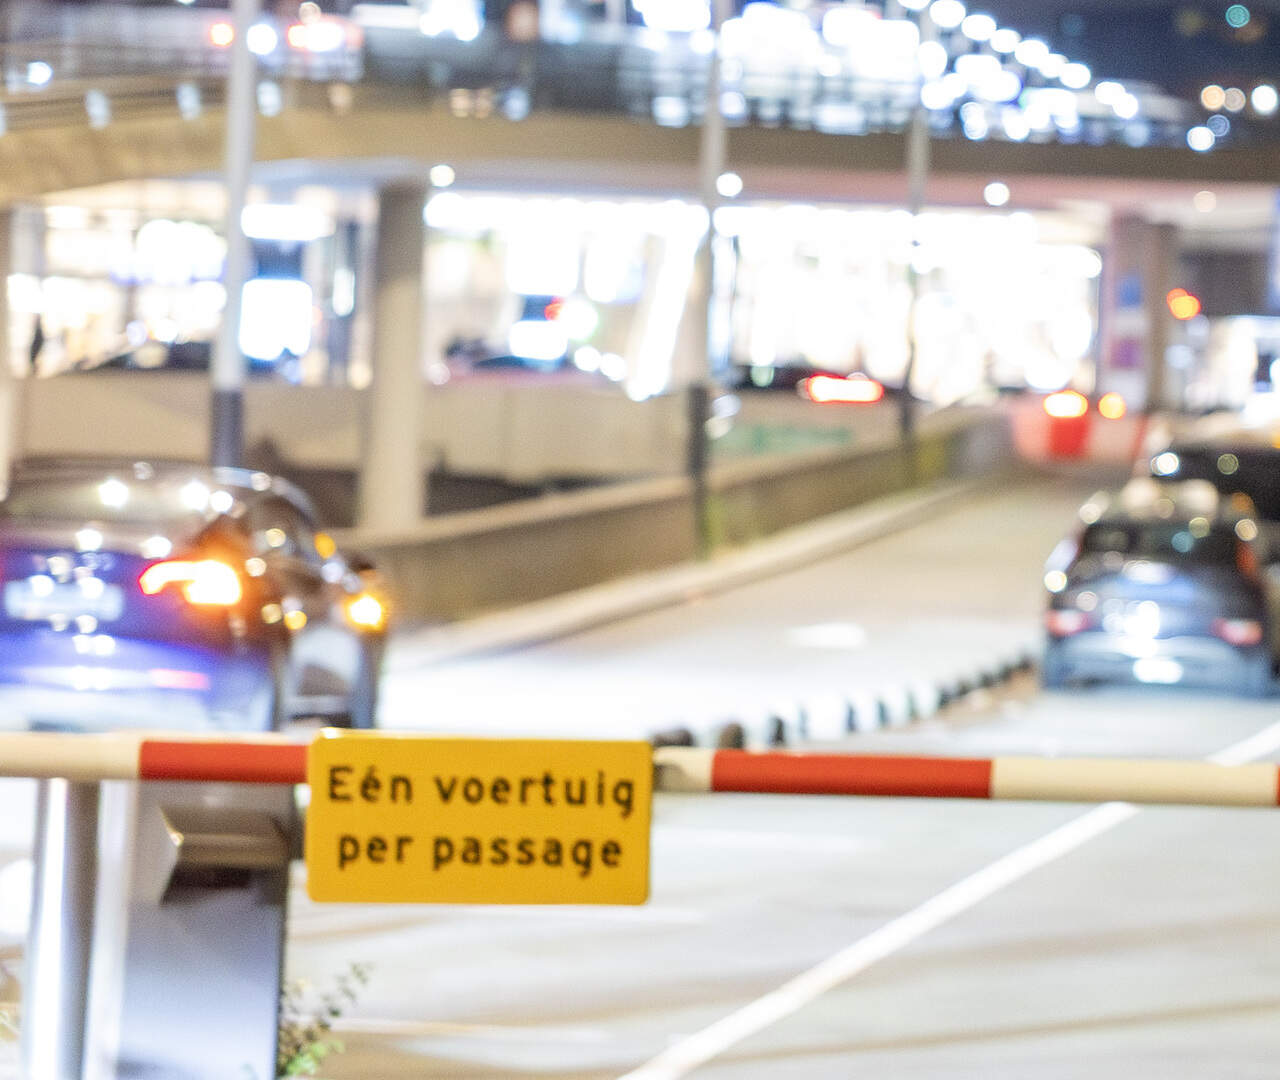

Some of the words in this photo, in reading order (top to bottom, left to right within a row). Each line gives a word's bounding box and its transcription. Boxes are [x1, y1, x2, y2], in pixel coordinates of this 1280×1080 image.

[328, 765, 414, 804] Eén
[434, 772, 635, 819] voertuig
[338, 835, 414, 870] per
[433, 836, 623, 879] passage
